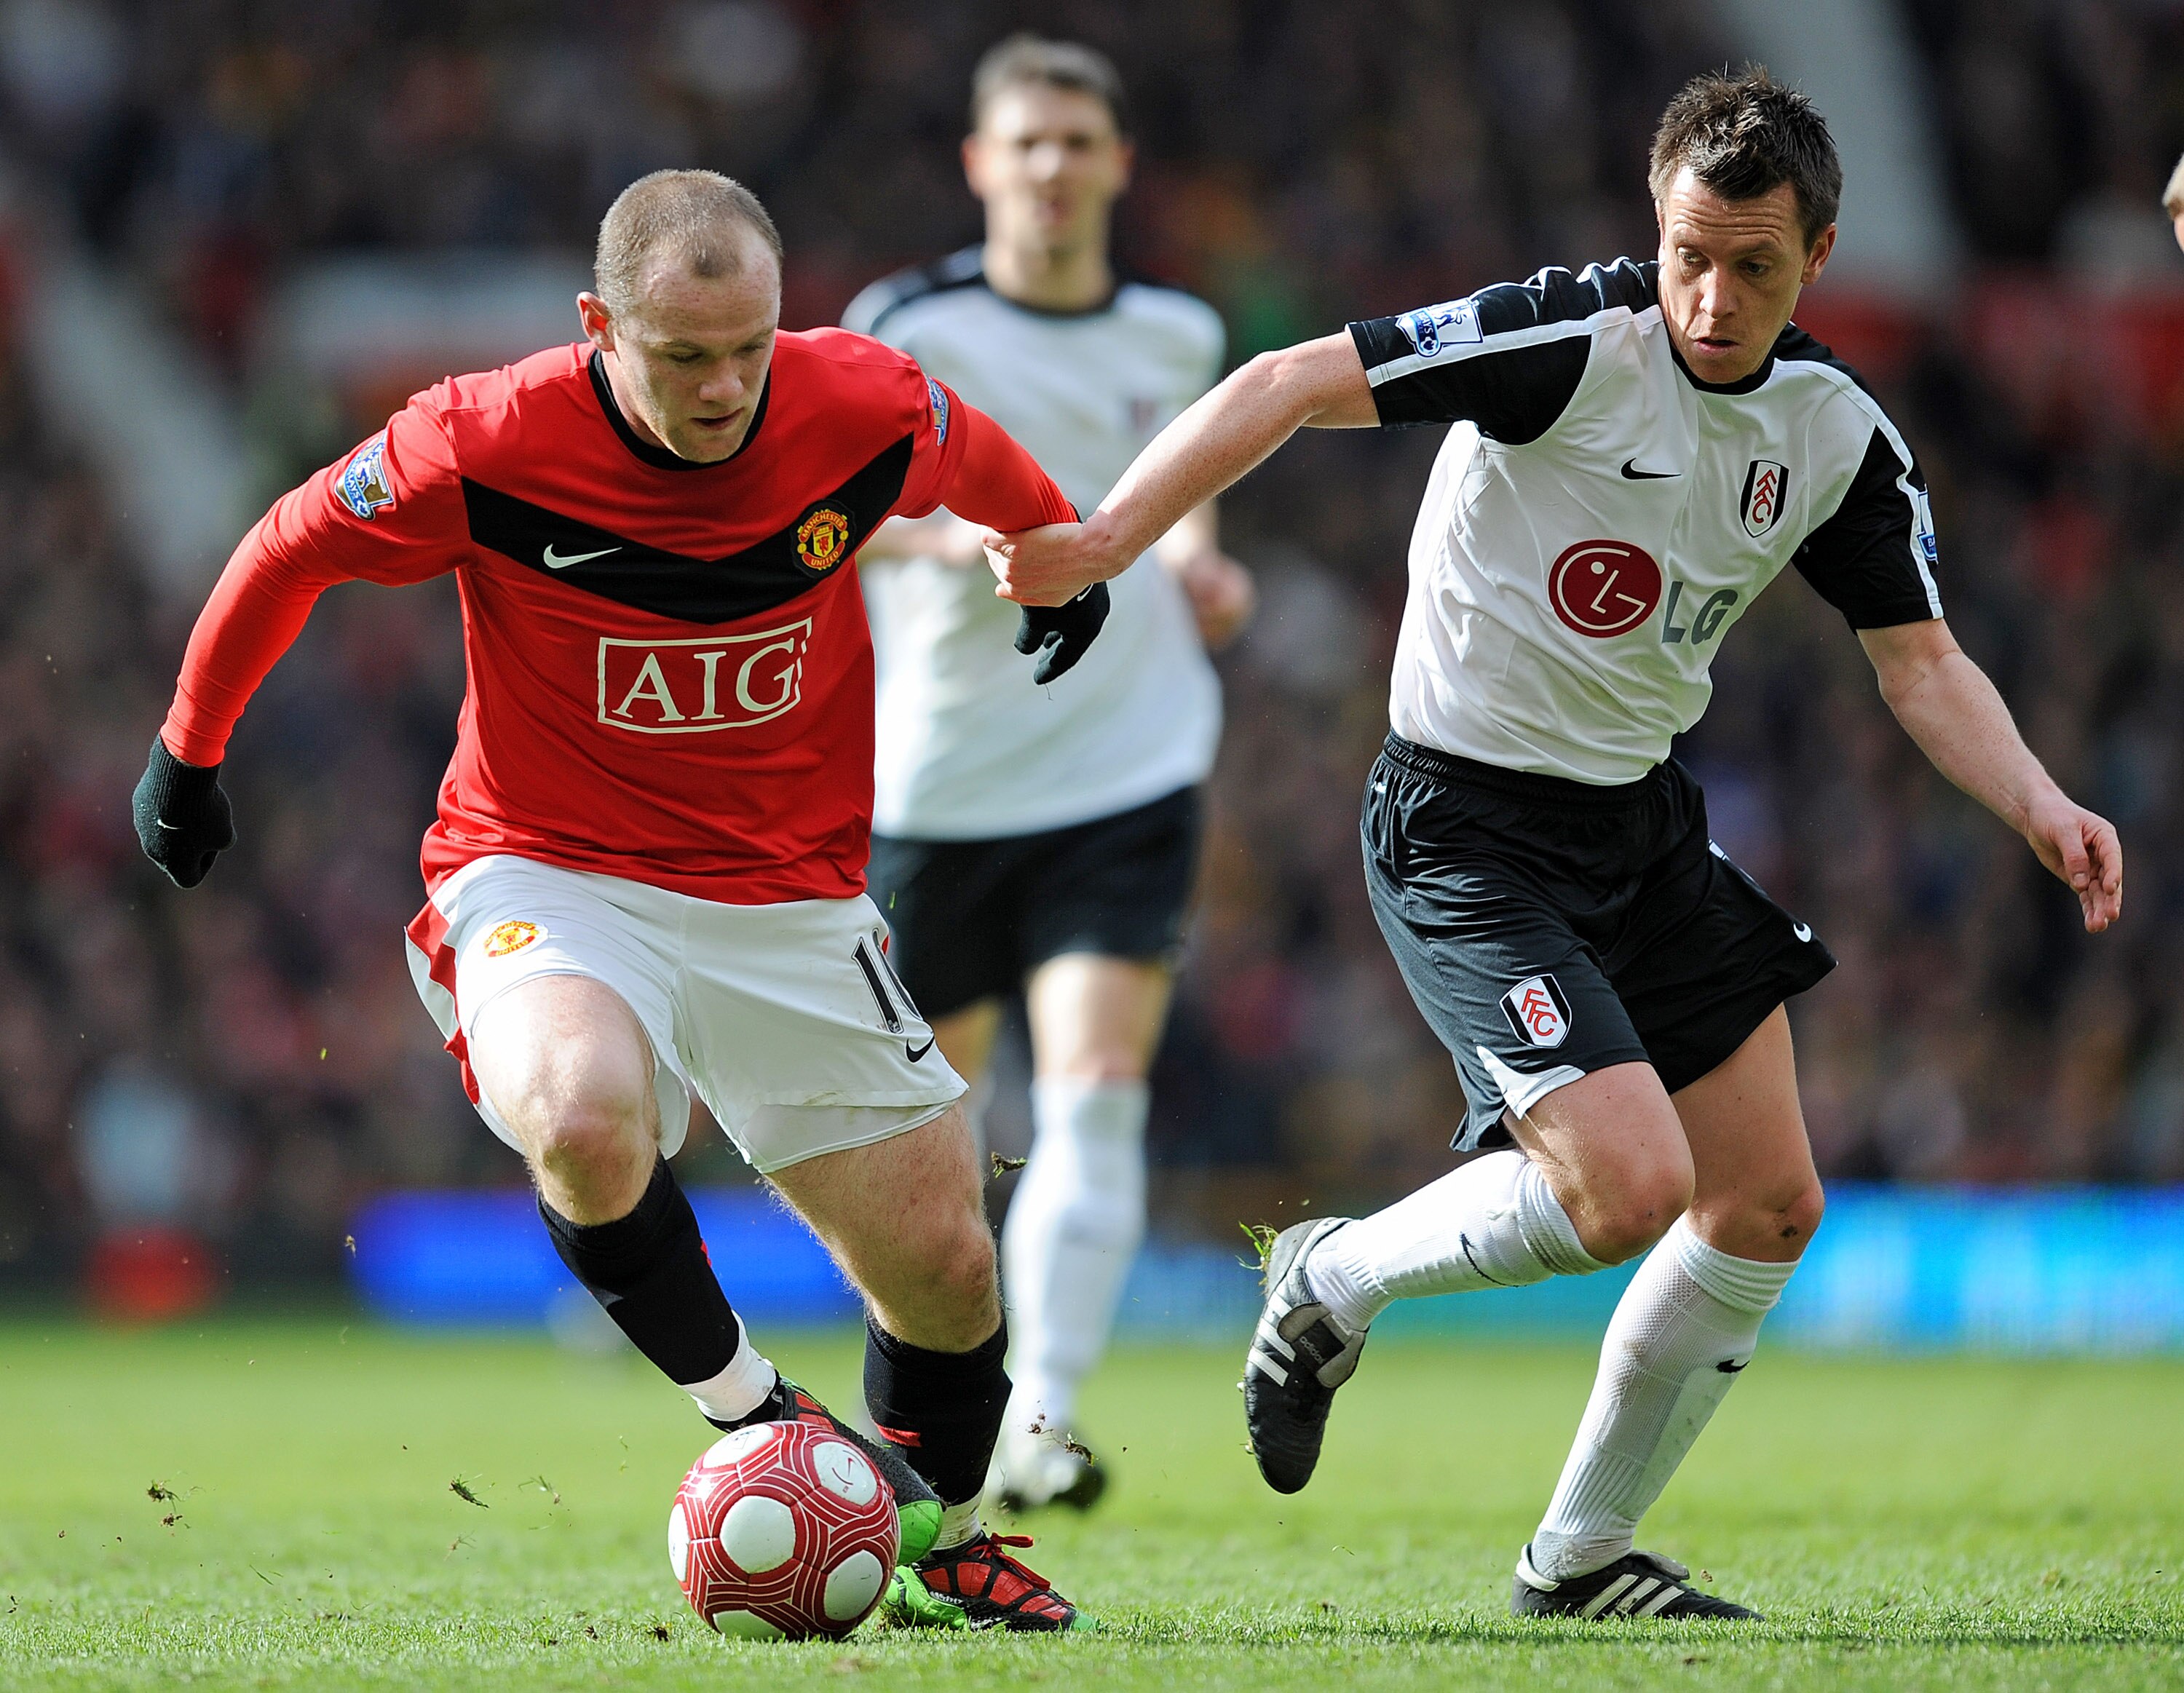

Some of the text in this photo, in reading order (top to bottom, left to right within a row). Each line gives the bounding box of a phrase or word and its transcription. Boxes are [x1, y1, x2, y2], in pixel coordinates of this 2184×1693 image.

[1752, 469, 1777, 524] FFC
[802, 512, 844, 538] MANCHESTER
[810, 551, 839, 566] UNITED
[1661, 581, 1738, 645] LG
[612, 638, 795, 720] AIG
[1521, 988, 1557, 1036] FFC
